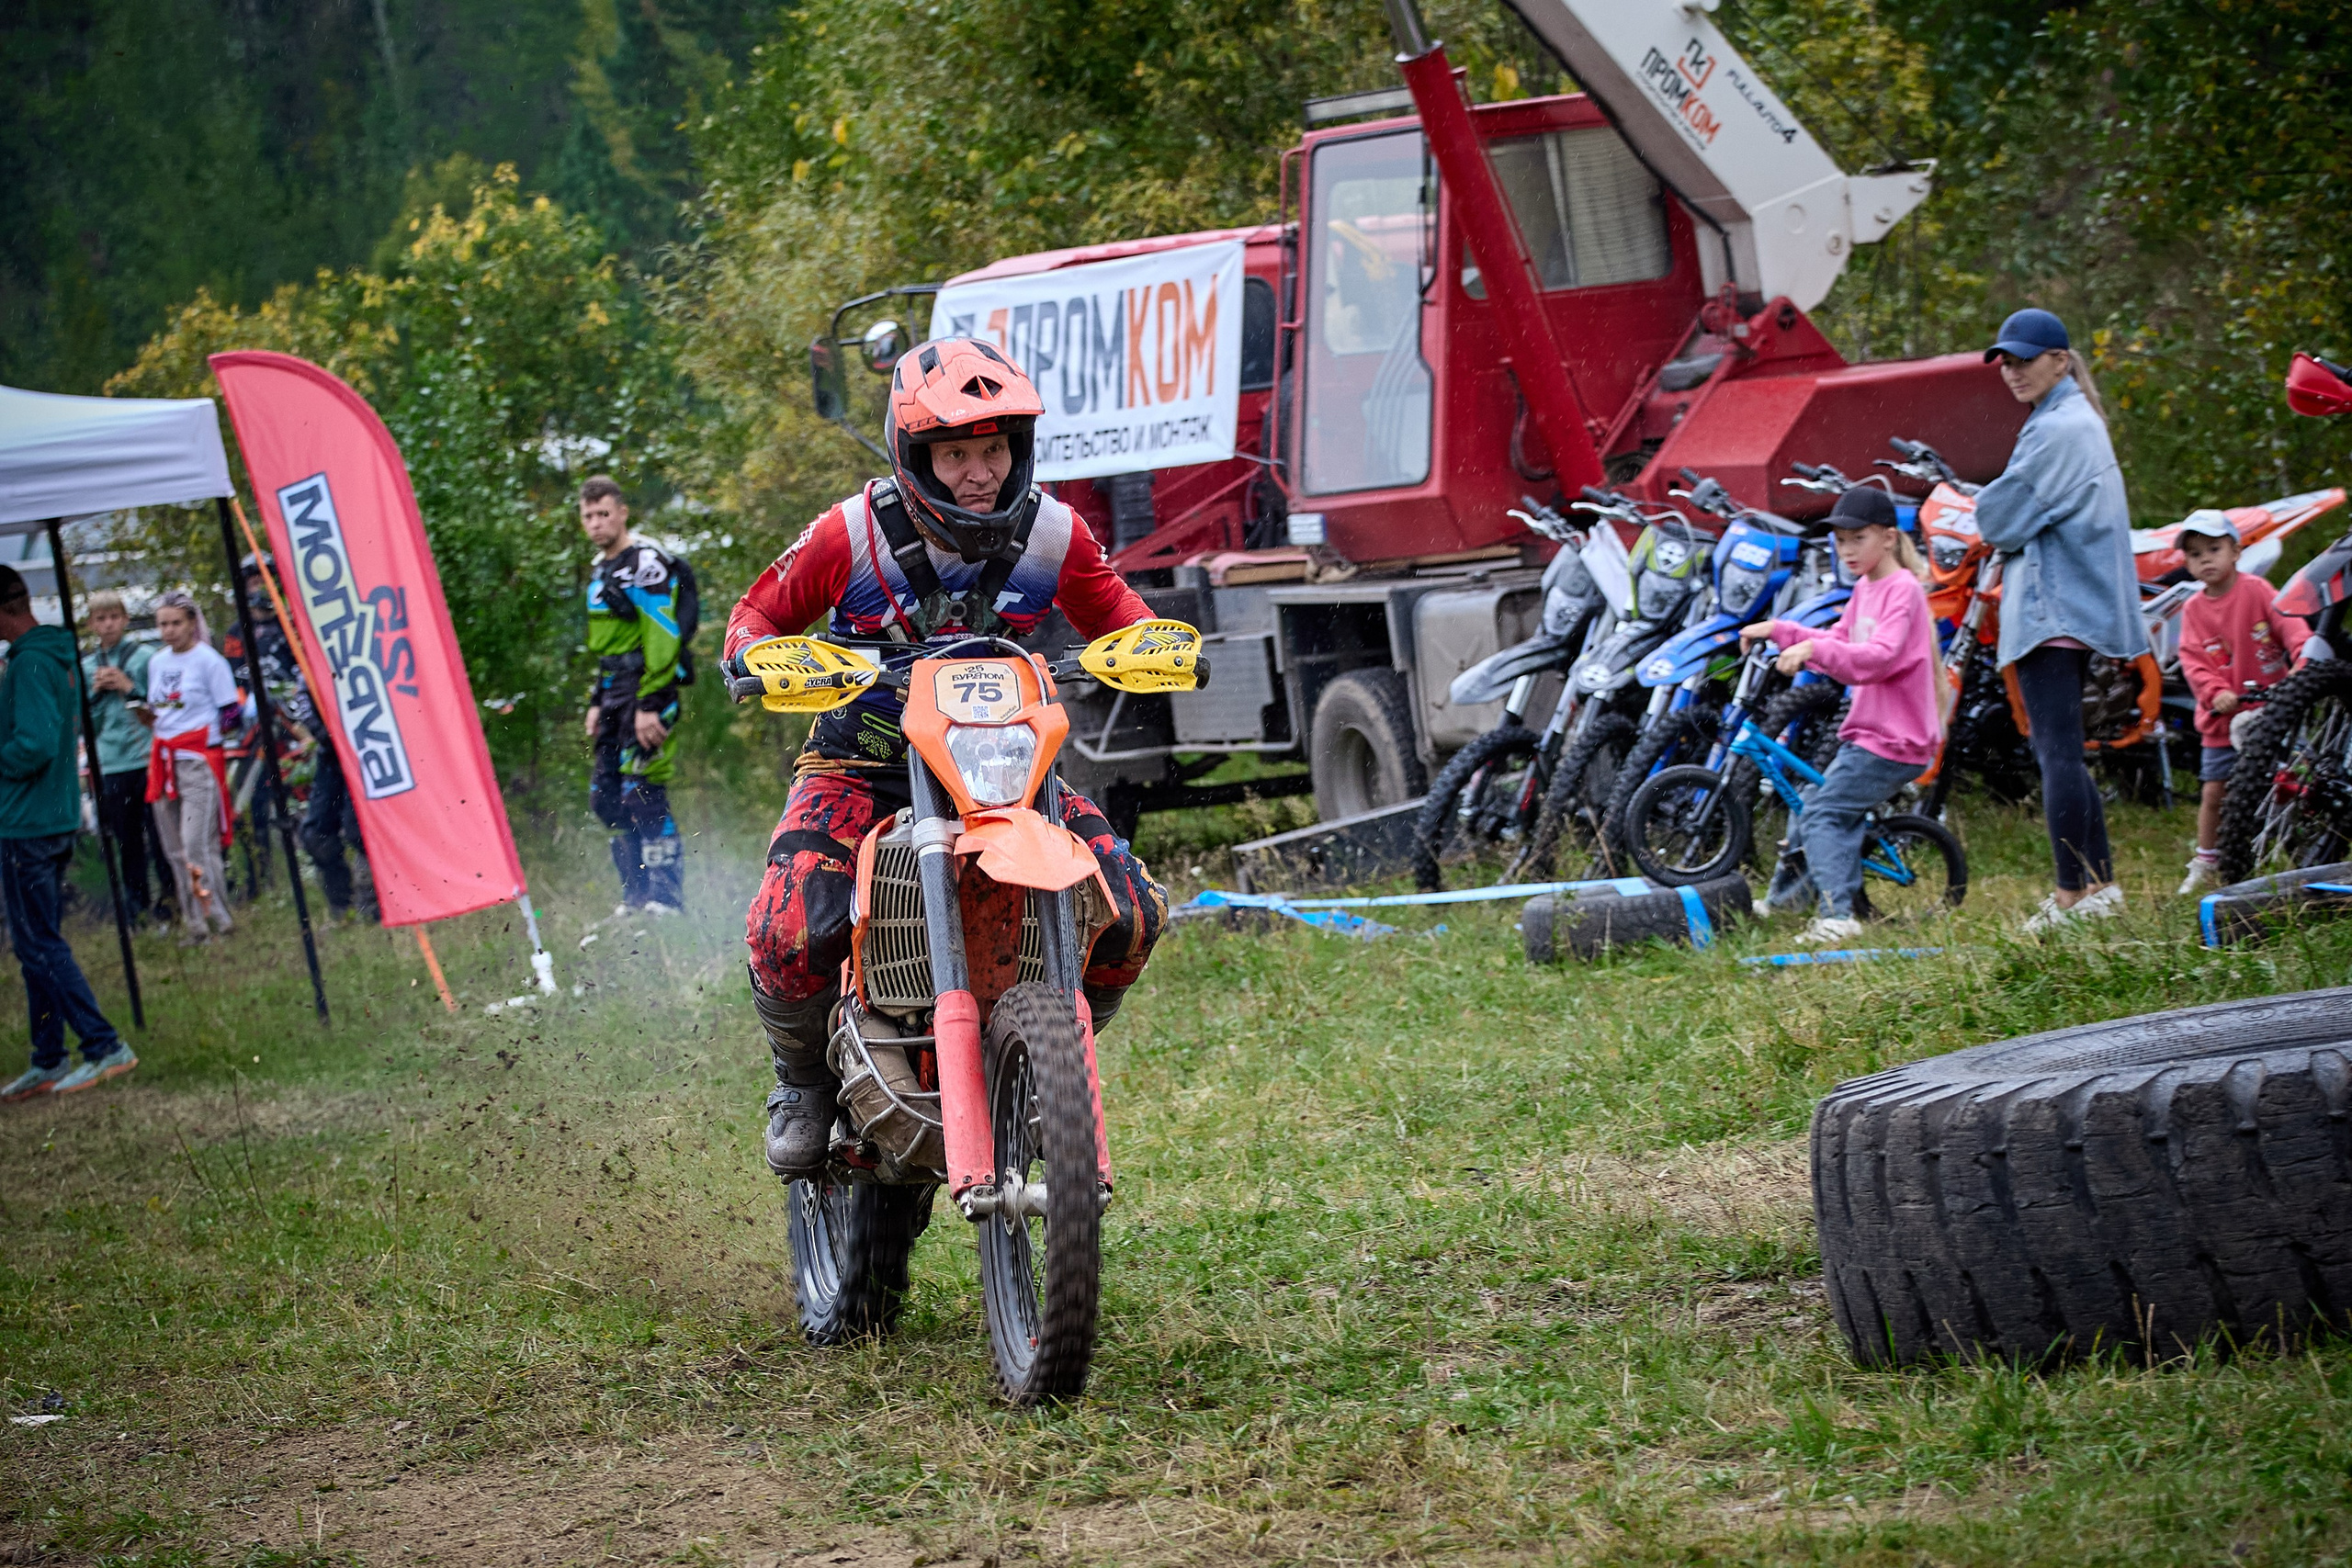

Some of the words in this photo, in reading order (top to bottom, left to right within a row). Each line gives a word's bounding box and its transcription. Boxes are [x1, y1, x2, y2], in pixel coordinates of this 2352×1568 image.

[1640, 46, 1723, 145] ПРОМКОМ
[805, 676, 832, 688] CYCRA
[953, 682, 1003, 704] 75
